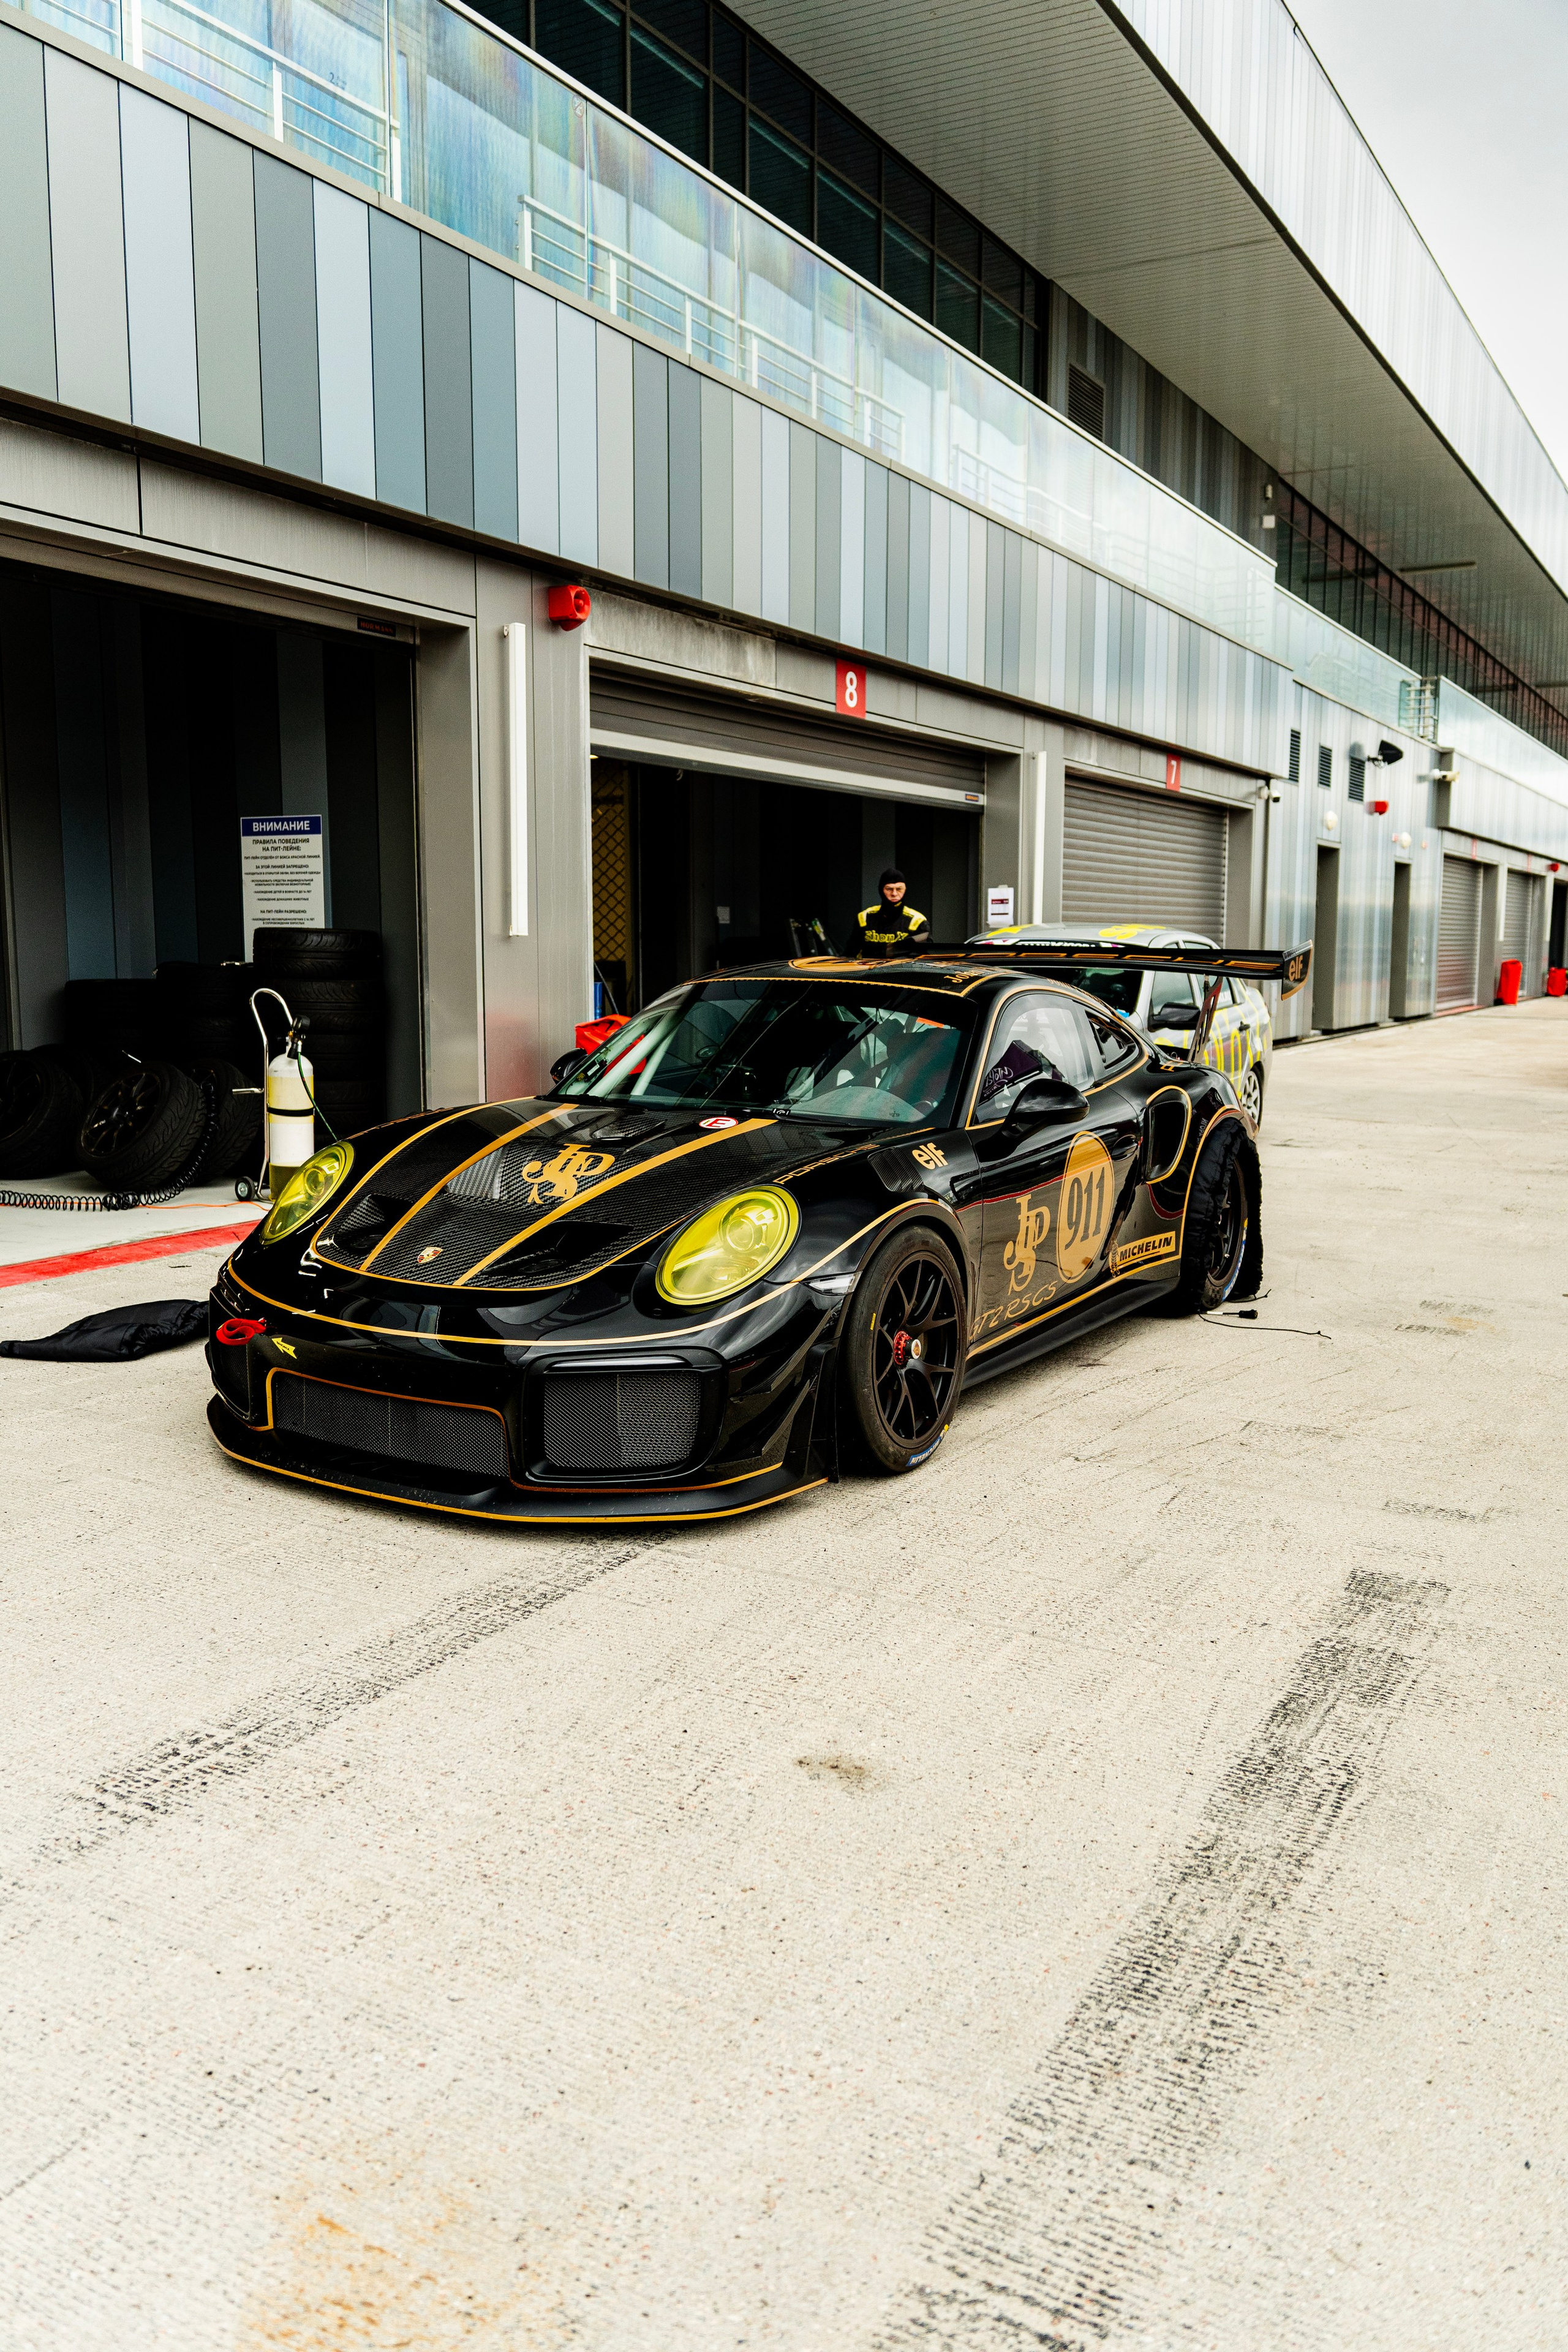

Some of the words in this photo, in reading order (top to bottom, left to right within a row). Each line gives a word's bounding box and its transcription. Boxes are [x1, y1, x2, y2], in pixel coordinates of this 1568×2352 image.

[845, 671, 858, 707] 8
[1170, 760, 1177, 785] 7
[252, 821, 311, 832] ВНИМАНИЕ
[1288, 954, 1303, 982] elf
[706, 1118, 731, 1128] E
[772, 1143, 881, 1185] PORSCHE
[912, 1142, 949, 1170] elf
[1065, 1167, 1105, 1251] 911
[1120, 1235, 1173, 1262] MICHELIN
